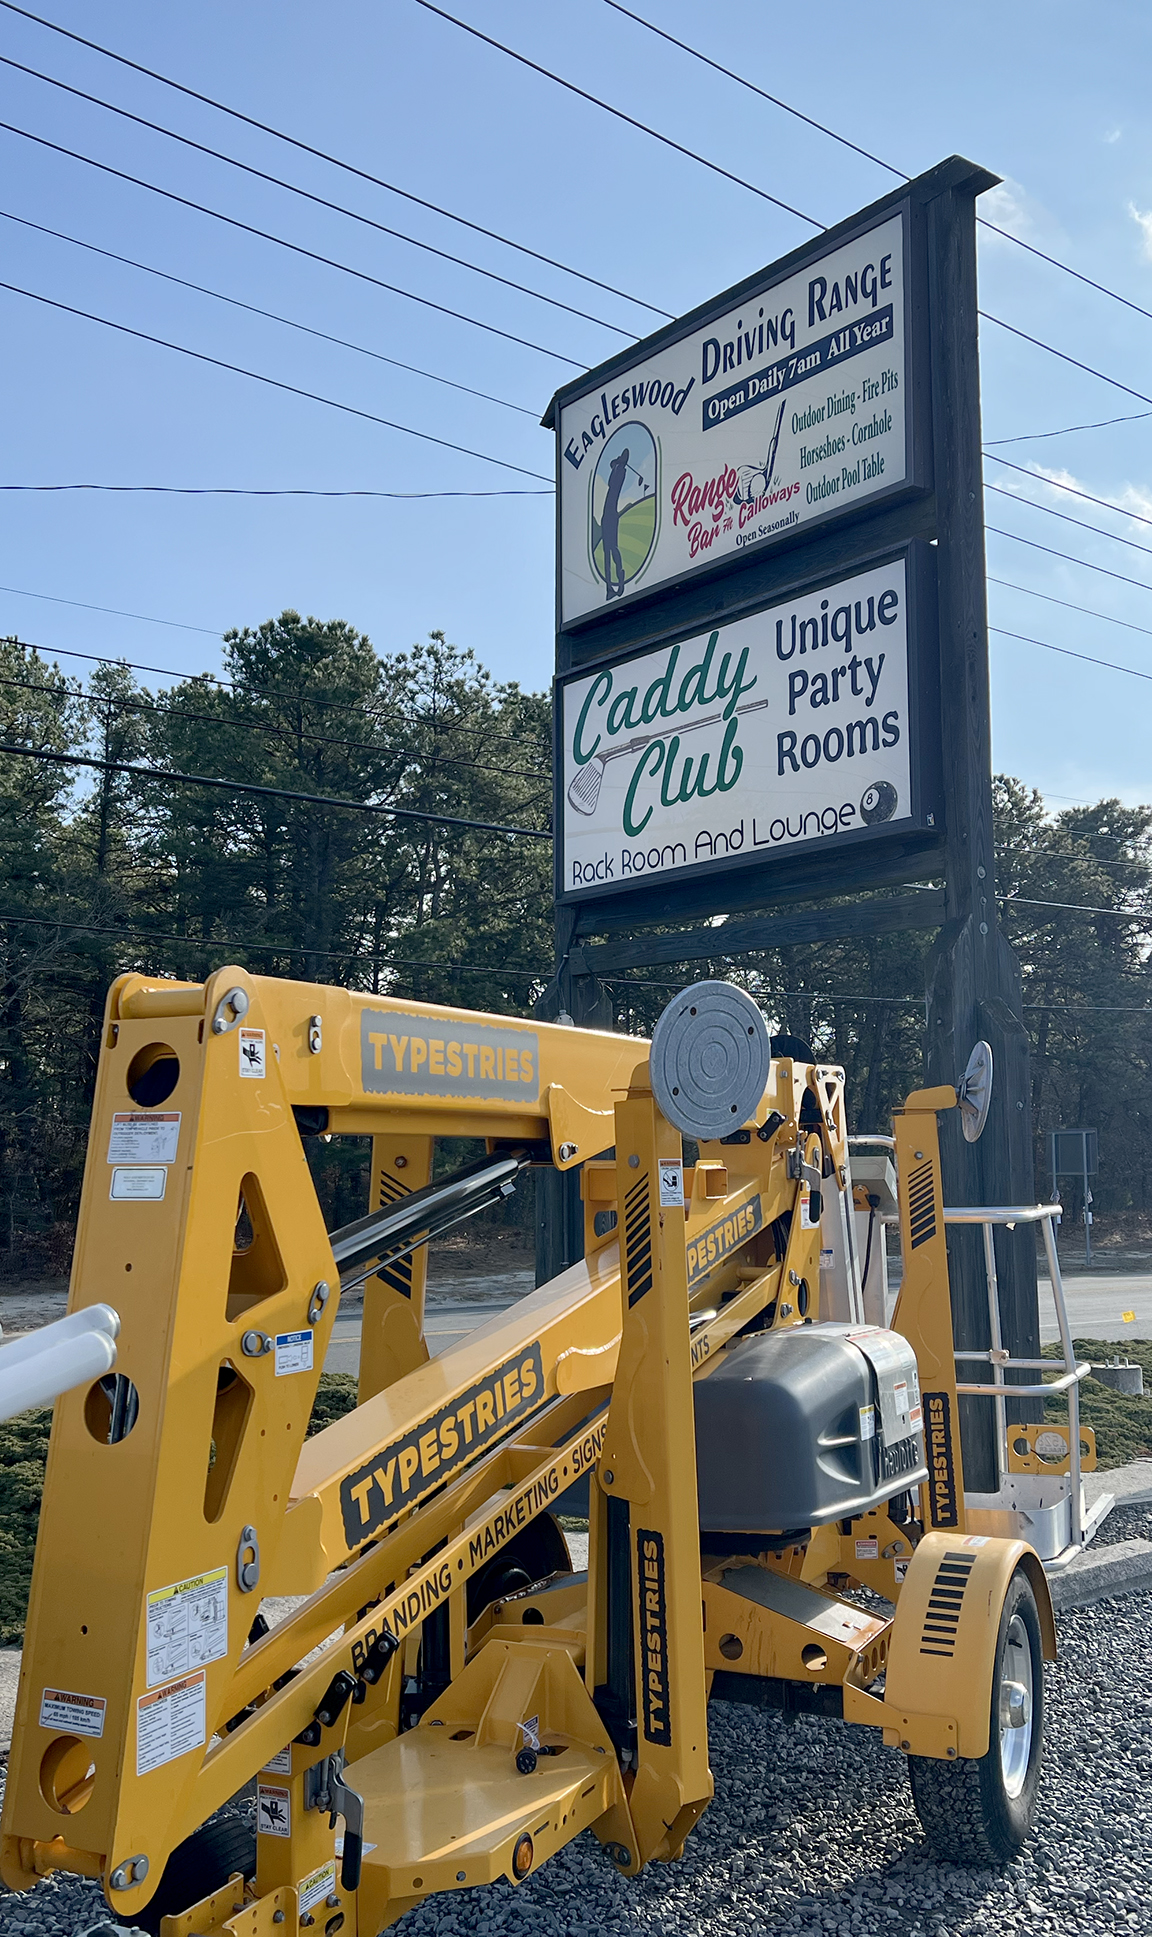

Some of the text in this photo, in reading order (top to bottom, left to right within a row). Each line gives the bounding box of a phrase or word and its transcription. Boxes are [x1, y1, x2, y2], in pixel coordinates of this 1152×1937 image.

[708, 316, 890, 419] Open Daily 7am All Year
[791, 404, 825, 435] Outdoor
[827, 389, 855, 419] Dining
[862, 378, 879, 403] Fire
[881, 368, 898, 394] Pits
[800, 434, 845, 469] Horseshoes
[851, 409, 892, 446] Cornhole
[671, 463, 740, 526] Range
[806, 451, 885, 504] Outdoor Pool Table
[688, 521, 720, 558] Bar
[739, 482, 800, 529] Calloways
[736, 511, 800, 547] Open Seasonally
[775, 589, 899, 661] Unique
[573, 630, 757, 766] Caddy
[788, 653, 885, 715] Party
[777, 710, 900, 776] Rooms
[623, 717, 743, 837] Club
[866, 793, 873, 805] 8
[573, 802, 856, 885] Rack Room And Lounge
[368, 1032, 534, 1083] TYPESTRIES
[687, 1205, 755, 1276] PESTRIES
[351, 1358, 537, 1525] TYPESTRIES
[929, 1398, 951, 1522] TYPESTRIES
[468, 1468, 559, 1567] MARKETING
[179, 1578, 203, 1592] CAUTION
[643, 1540, 664, 1733] TYPESTRIES
[60, 1694, 94, 1707] WARNING
[272, 1825, 288, 1833] CLEAR
